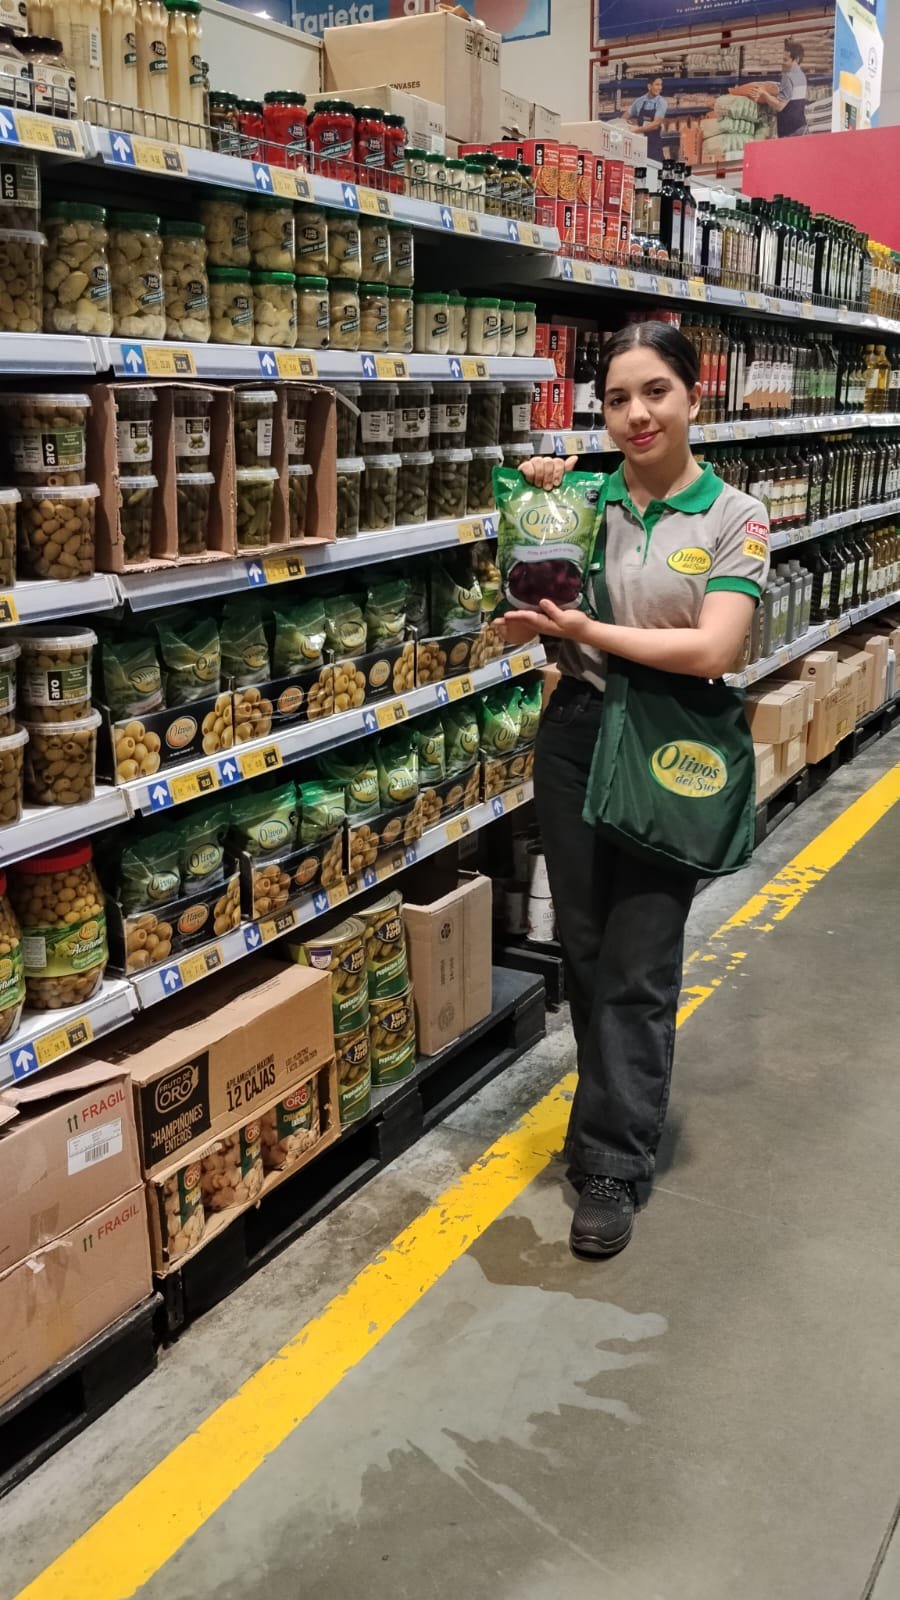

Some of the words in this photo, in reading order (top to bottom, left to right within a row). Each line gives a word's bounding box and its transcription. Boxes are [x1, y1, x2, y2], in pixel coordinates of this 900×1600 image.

[4, 173, 14, 198] aro
[46, 443, 55, 465] aro
[672, 551, 706, 564] Olivos
[51, 680, 60, 699] aro
[657, 744, 720, 779] Olivos
[675, 774, 692, 786] del
[695, 777, 714, 792] Sur
[160, 1076, 180, 1093] FRUTO
[183, 1070, 192, 1081] DE
[160, 1080, 190, 1106] ORO
[227, 1085, 242, 1112] 12
[245, 1063, 275, 1101] CAJAS
[82, 1089, 126, 1122] FRAGIL
[286, 1092, 307, 1107] ORO
[164, 1126, 192, 1154] ENTEROS
[97, 1203, 140, 1240] FRAGIL
